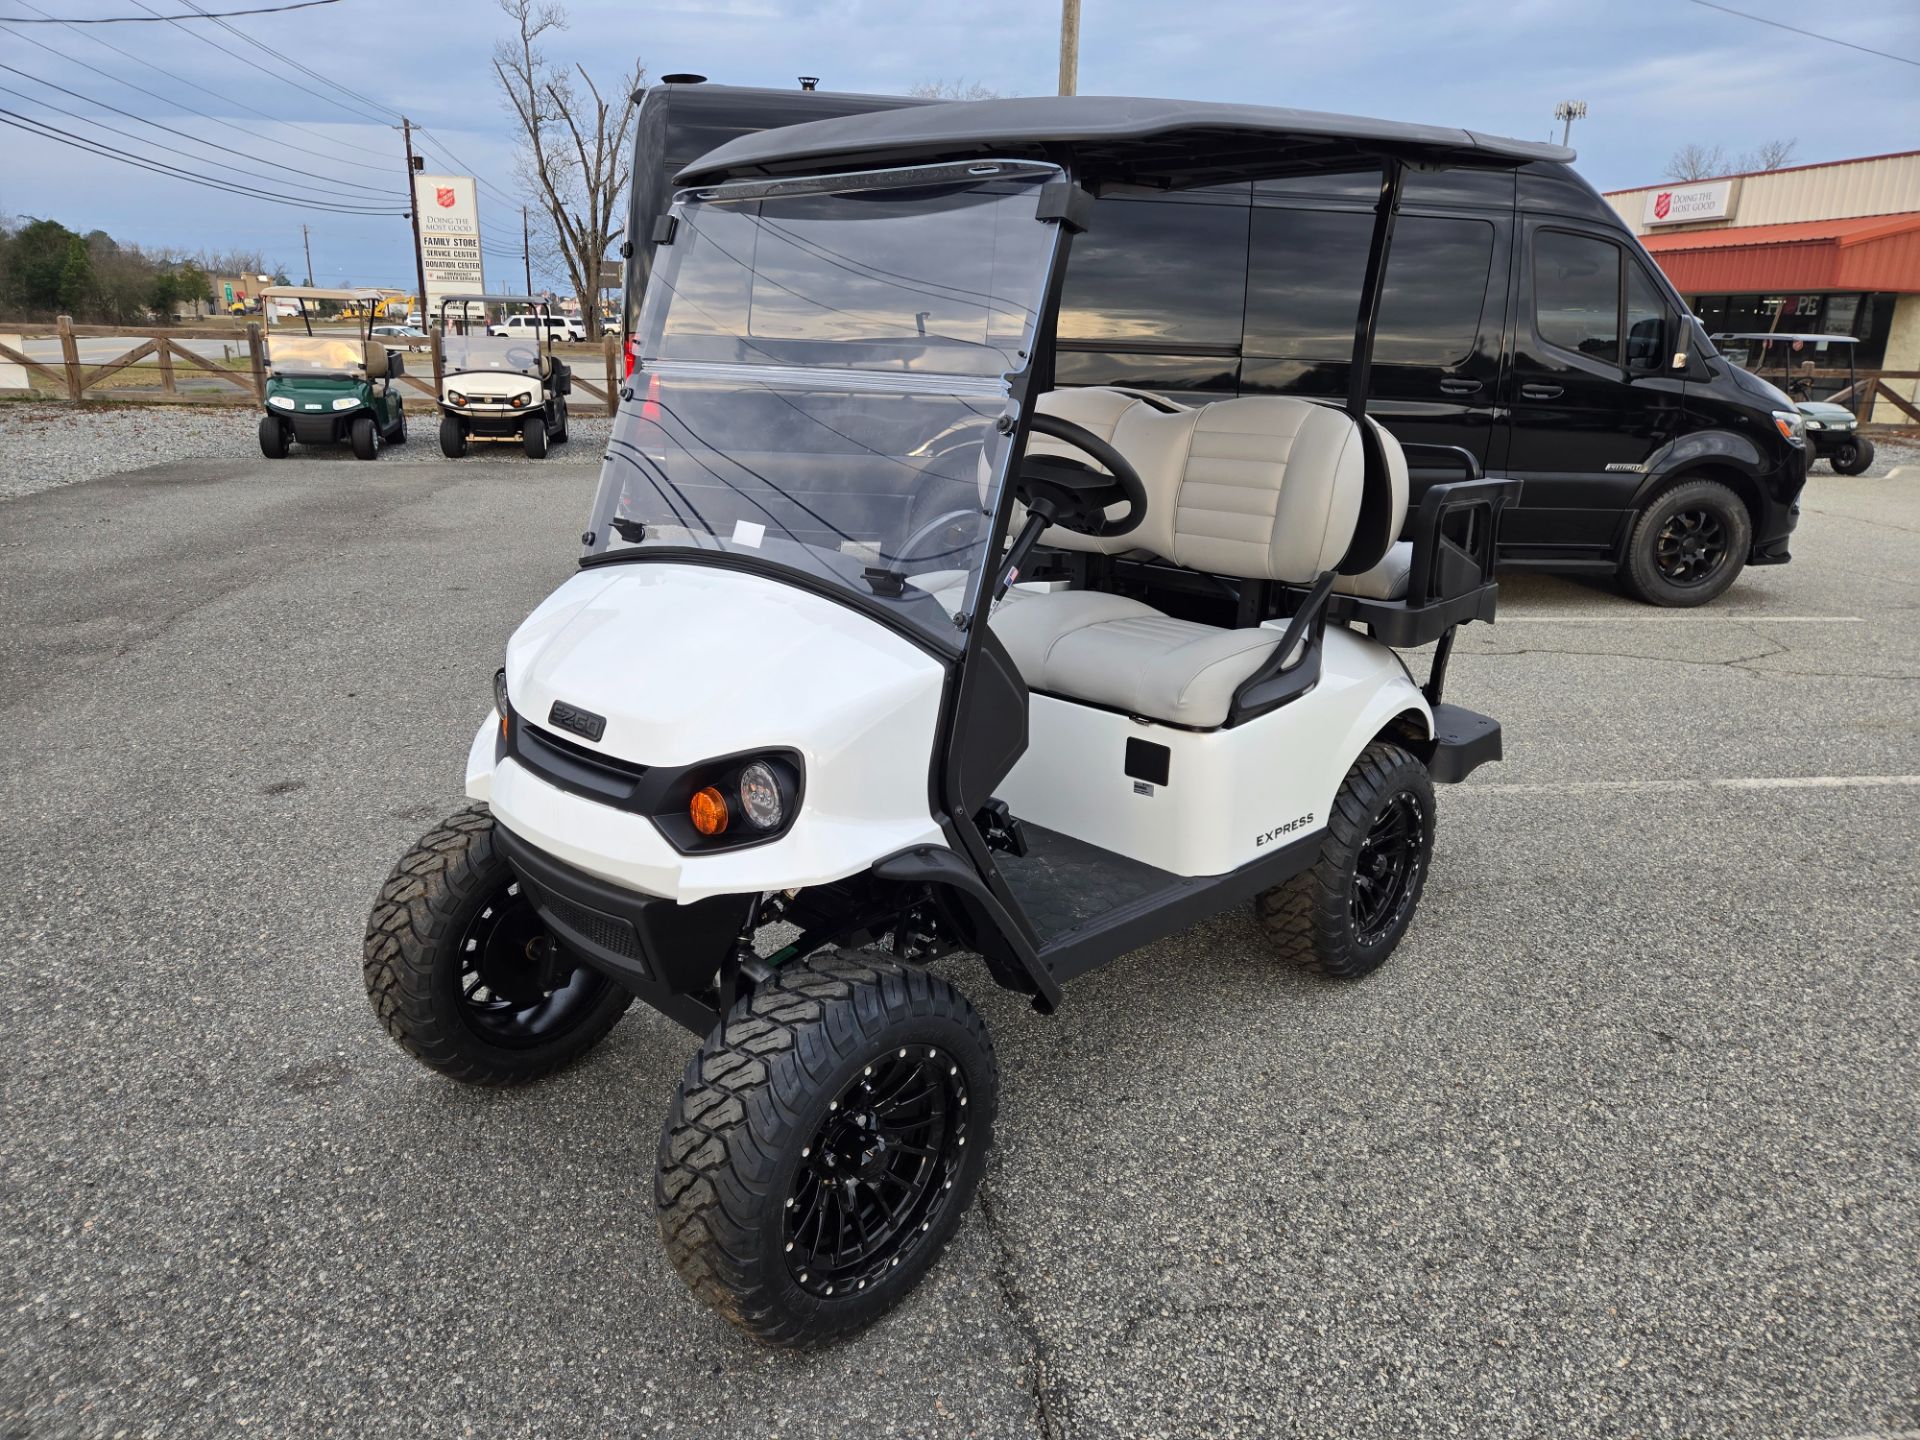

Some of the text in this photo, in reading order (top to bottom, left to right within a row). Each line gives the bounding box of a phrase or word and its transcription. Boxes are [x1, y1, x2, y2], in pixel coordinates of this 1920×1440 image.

[1674, 192, 1712, 204] DOING THE
[1672, 201, 1715, 213] MOST GOOD
[427, 216, 453, 224] DOING
[424, 237, 477, 247] FAMILY STORE
[426, 249, 450, 257] SERVICE
[1256, 812, 1314, 847] EXPRESS
